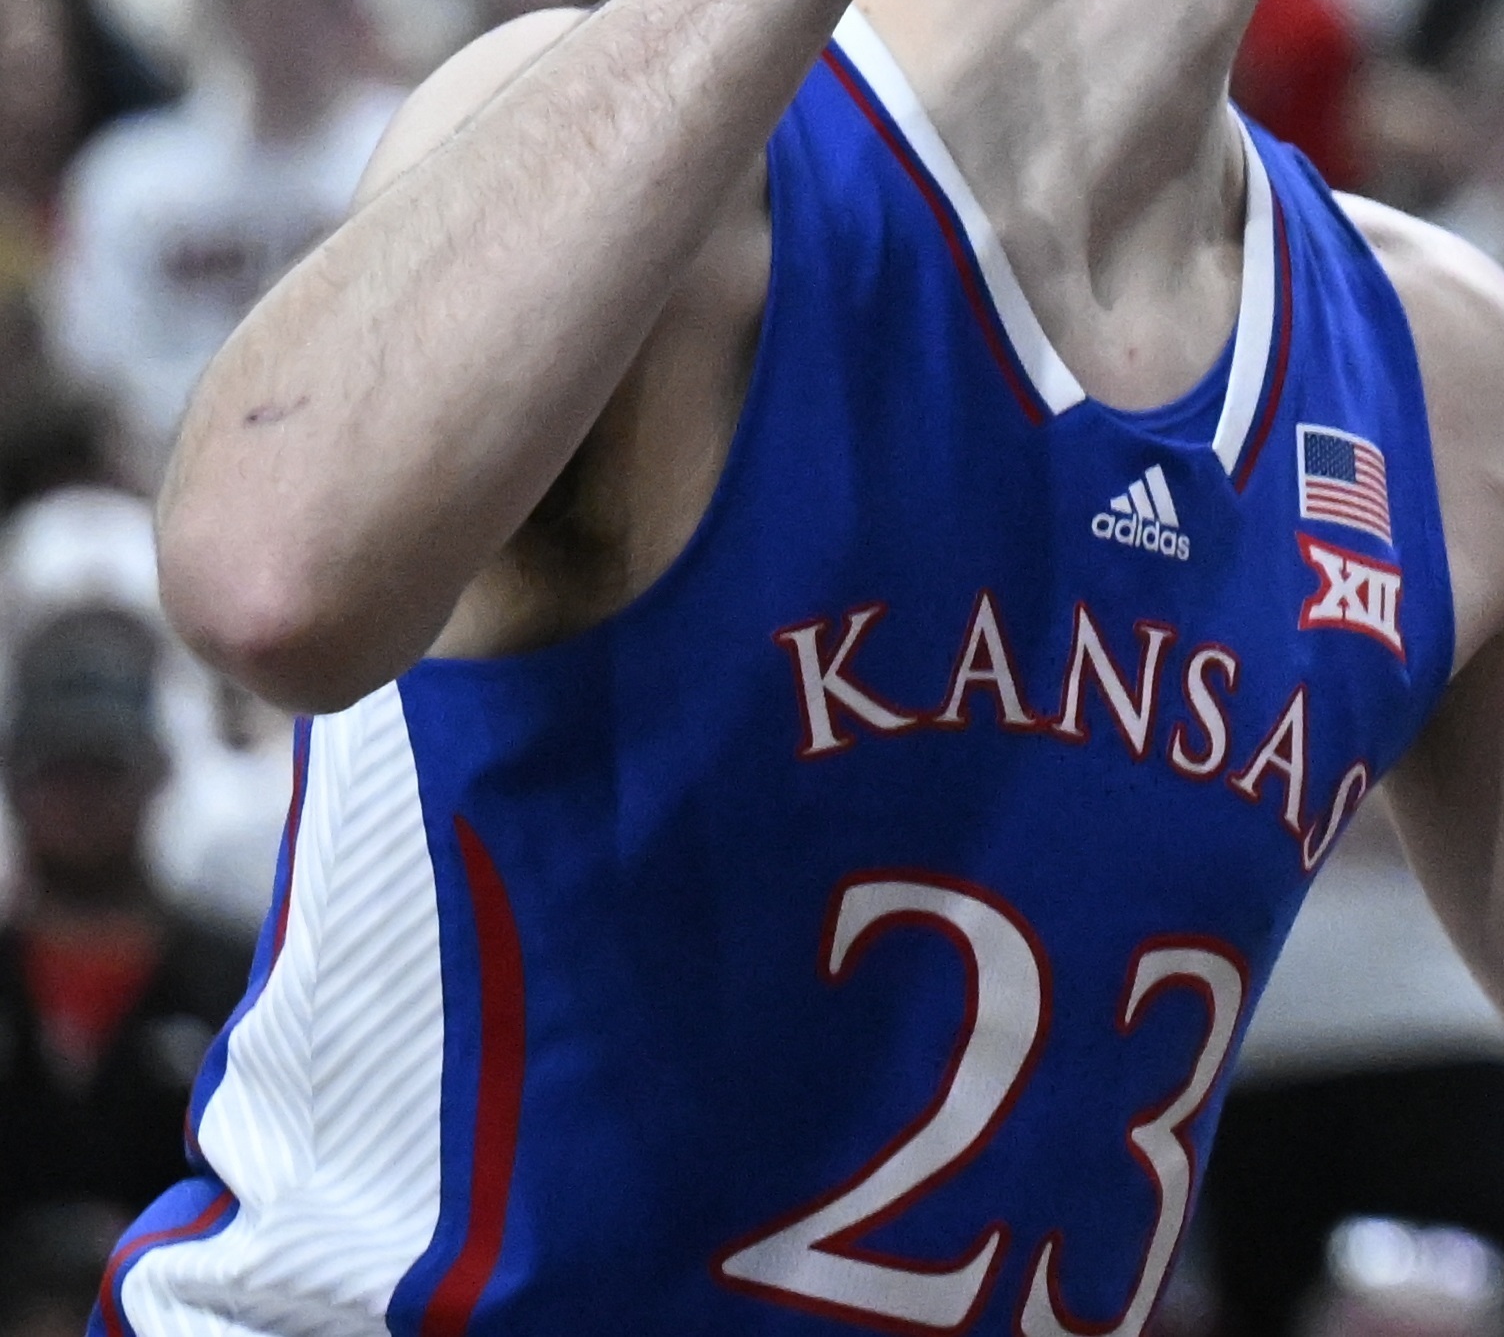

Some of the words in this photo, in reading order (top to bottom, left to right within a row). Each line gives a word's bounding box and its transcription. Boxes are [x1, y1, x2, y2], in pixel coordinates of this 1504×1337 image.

[1091, 512, 1190, 562] adidas
[1303, 536, 1404, 657] XII
[774, 589, 1369, 873] KANSAS
[711, 868, 1250, 1336] 23
